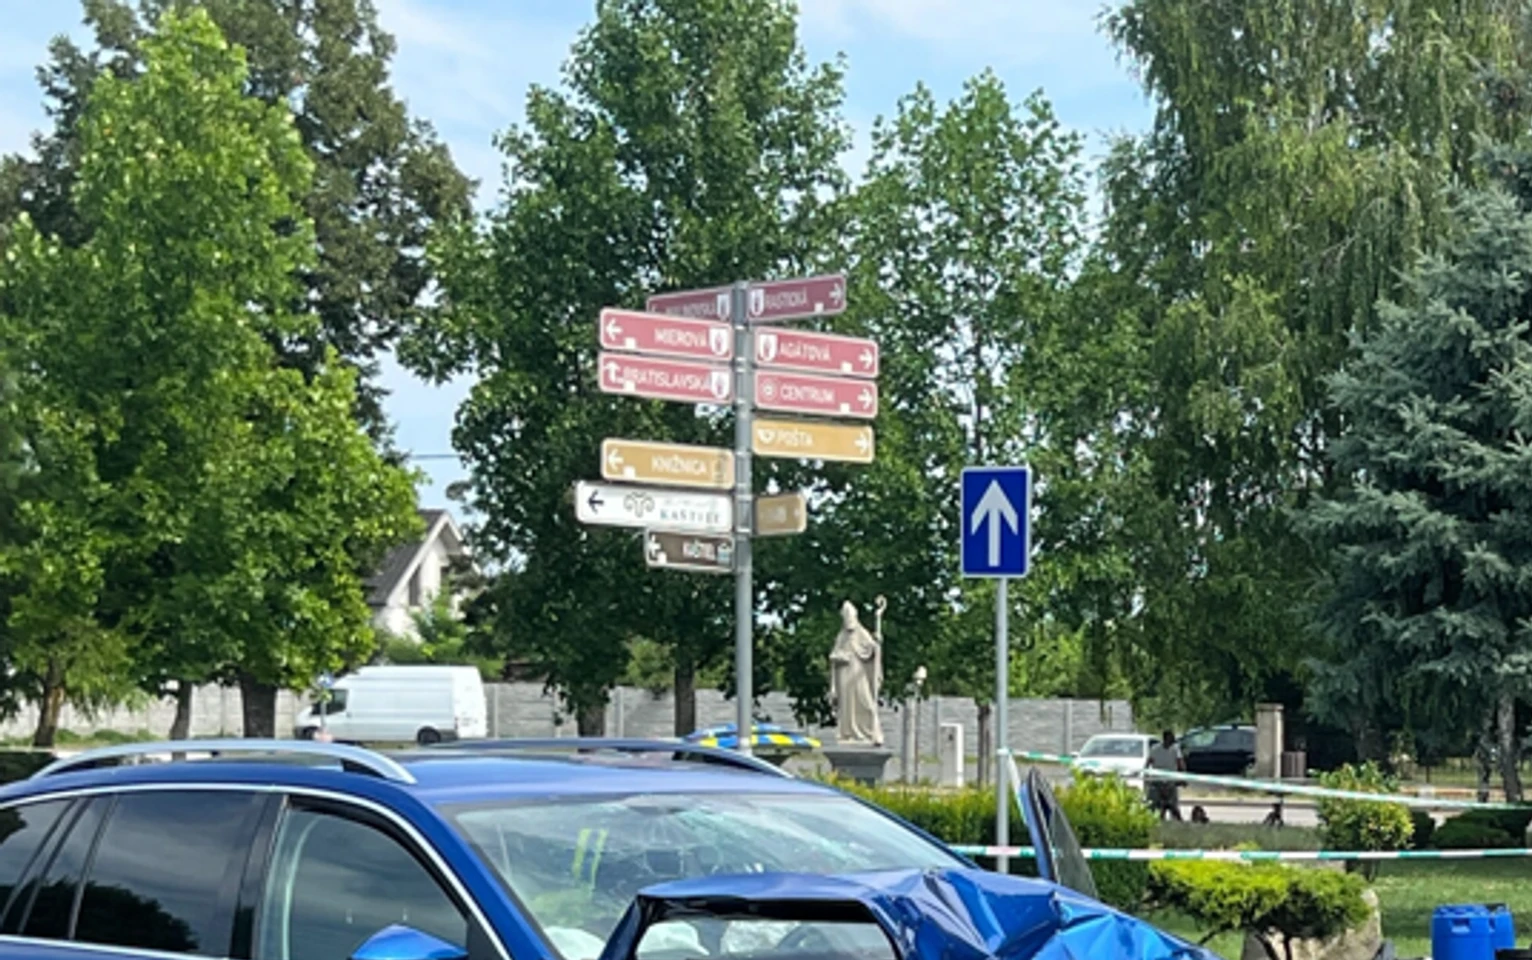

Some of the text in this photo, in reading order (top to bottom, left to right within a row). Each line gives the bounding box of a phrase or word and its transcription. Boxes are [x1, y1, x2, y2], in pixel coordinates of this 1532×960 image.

[654, 326, 707, 347] MIEROVÁ
[780, 384, 834, 404] CENTRUM
[777, 429, 813, 447] POŠTA
[652, 454, 707, 475] KNIŽNICA
